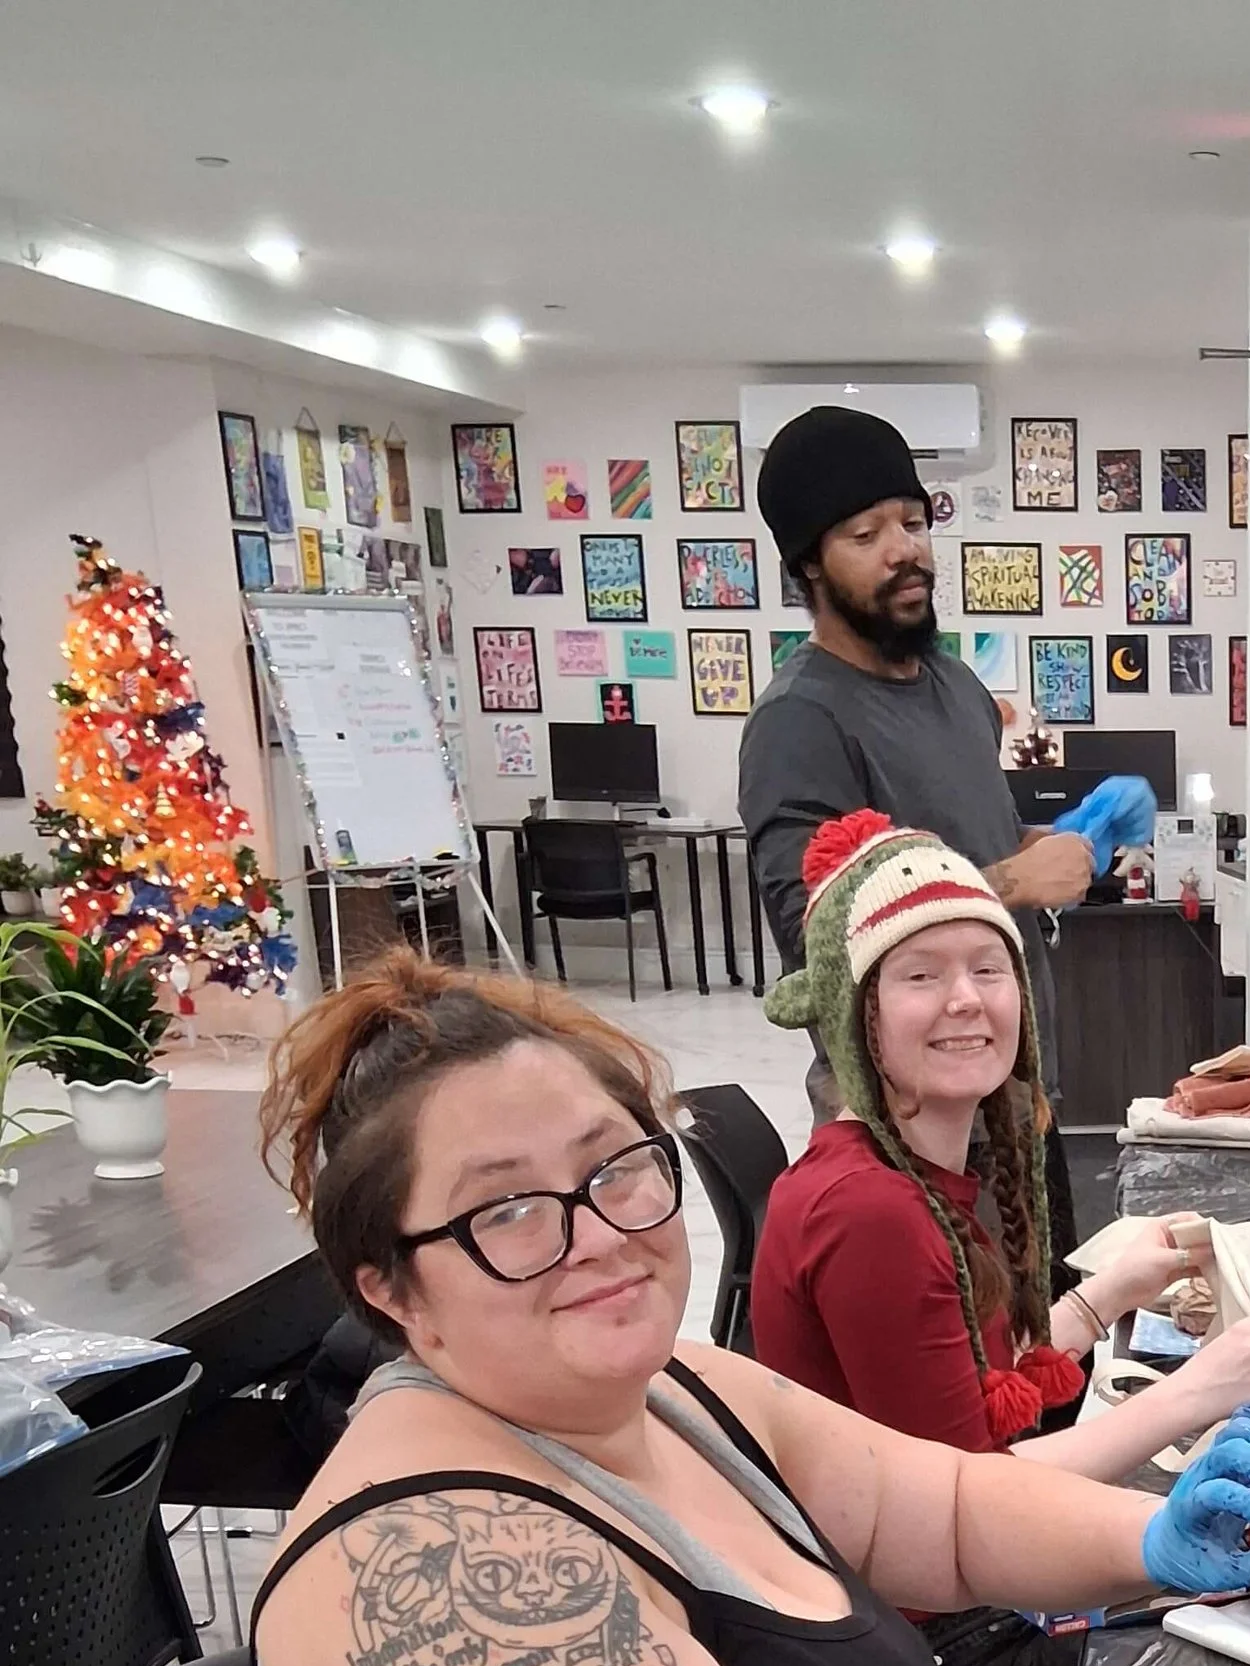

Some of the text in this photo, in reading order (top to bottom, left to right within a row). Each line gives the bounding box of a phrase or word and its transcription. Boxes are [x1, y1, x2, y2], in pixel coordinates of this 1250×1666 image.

[1027, 491, 1061, 506] ME
[592, 552, 634, 566] MANY
[680, 545, 749, 573] PERLESS
[1129, 539, 1183, 568] CLEAN
[971, 565, 1039, 589] SPIRITUAL
[590, 589, 644, 606] NEVER
[967, 587, 1039, 611] AWAKENING
[487, 633, 528, 648] LIFE
[693, 636, 744, 654] NEVER
[1036, 643, 1087, 662] BE KIND
[697, 658, 745, 681] GIVE
[1037, 673, 1089, 692] RESPECT
[701, 686, 738, 708] UP
